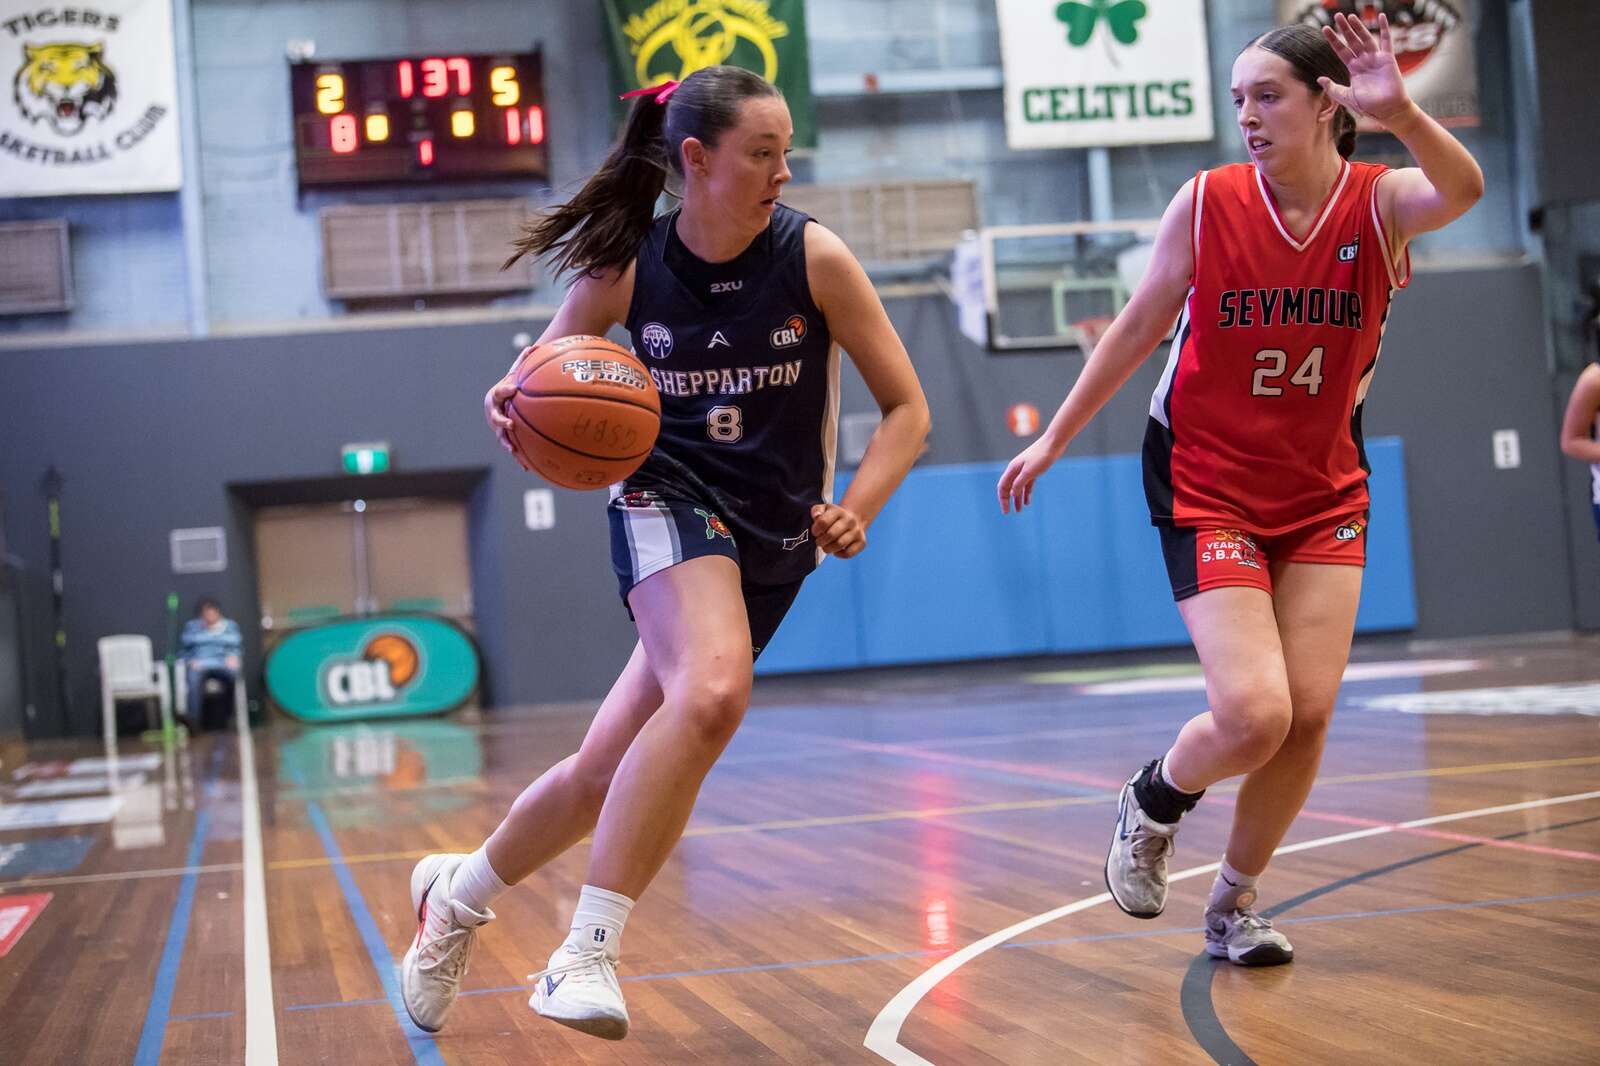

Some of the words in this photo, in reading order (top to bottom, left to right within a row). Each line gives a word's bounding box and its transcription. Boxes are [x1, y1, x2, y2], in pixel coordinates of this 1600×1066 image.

[3, 9, 120, 36] TIGERS
[315, 73, 345, 114] 2
[490, 66, 520, 107] 5
[1022, 81, 1194, 123] CELTICS
[115, 105, 167, 150] CLUB
[330, 114, 357, 153] 8
[506, 106, 544, 145] 11
[419, 139, 433, 166] 1
[710, 280, 743, 293] 2XU
[1218, 287, 1363, 331] SEYMOUR
[772, 329, 799, 347] CBL
[650, 360, 802, 397] SHEPPARTON
[1252, 346, 1325, 397] 24
[706, 405, 743, 444] 8
[1207, 541, 1241, 550] YEARS
[327, 658, 396, 703] CBL
